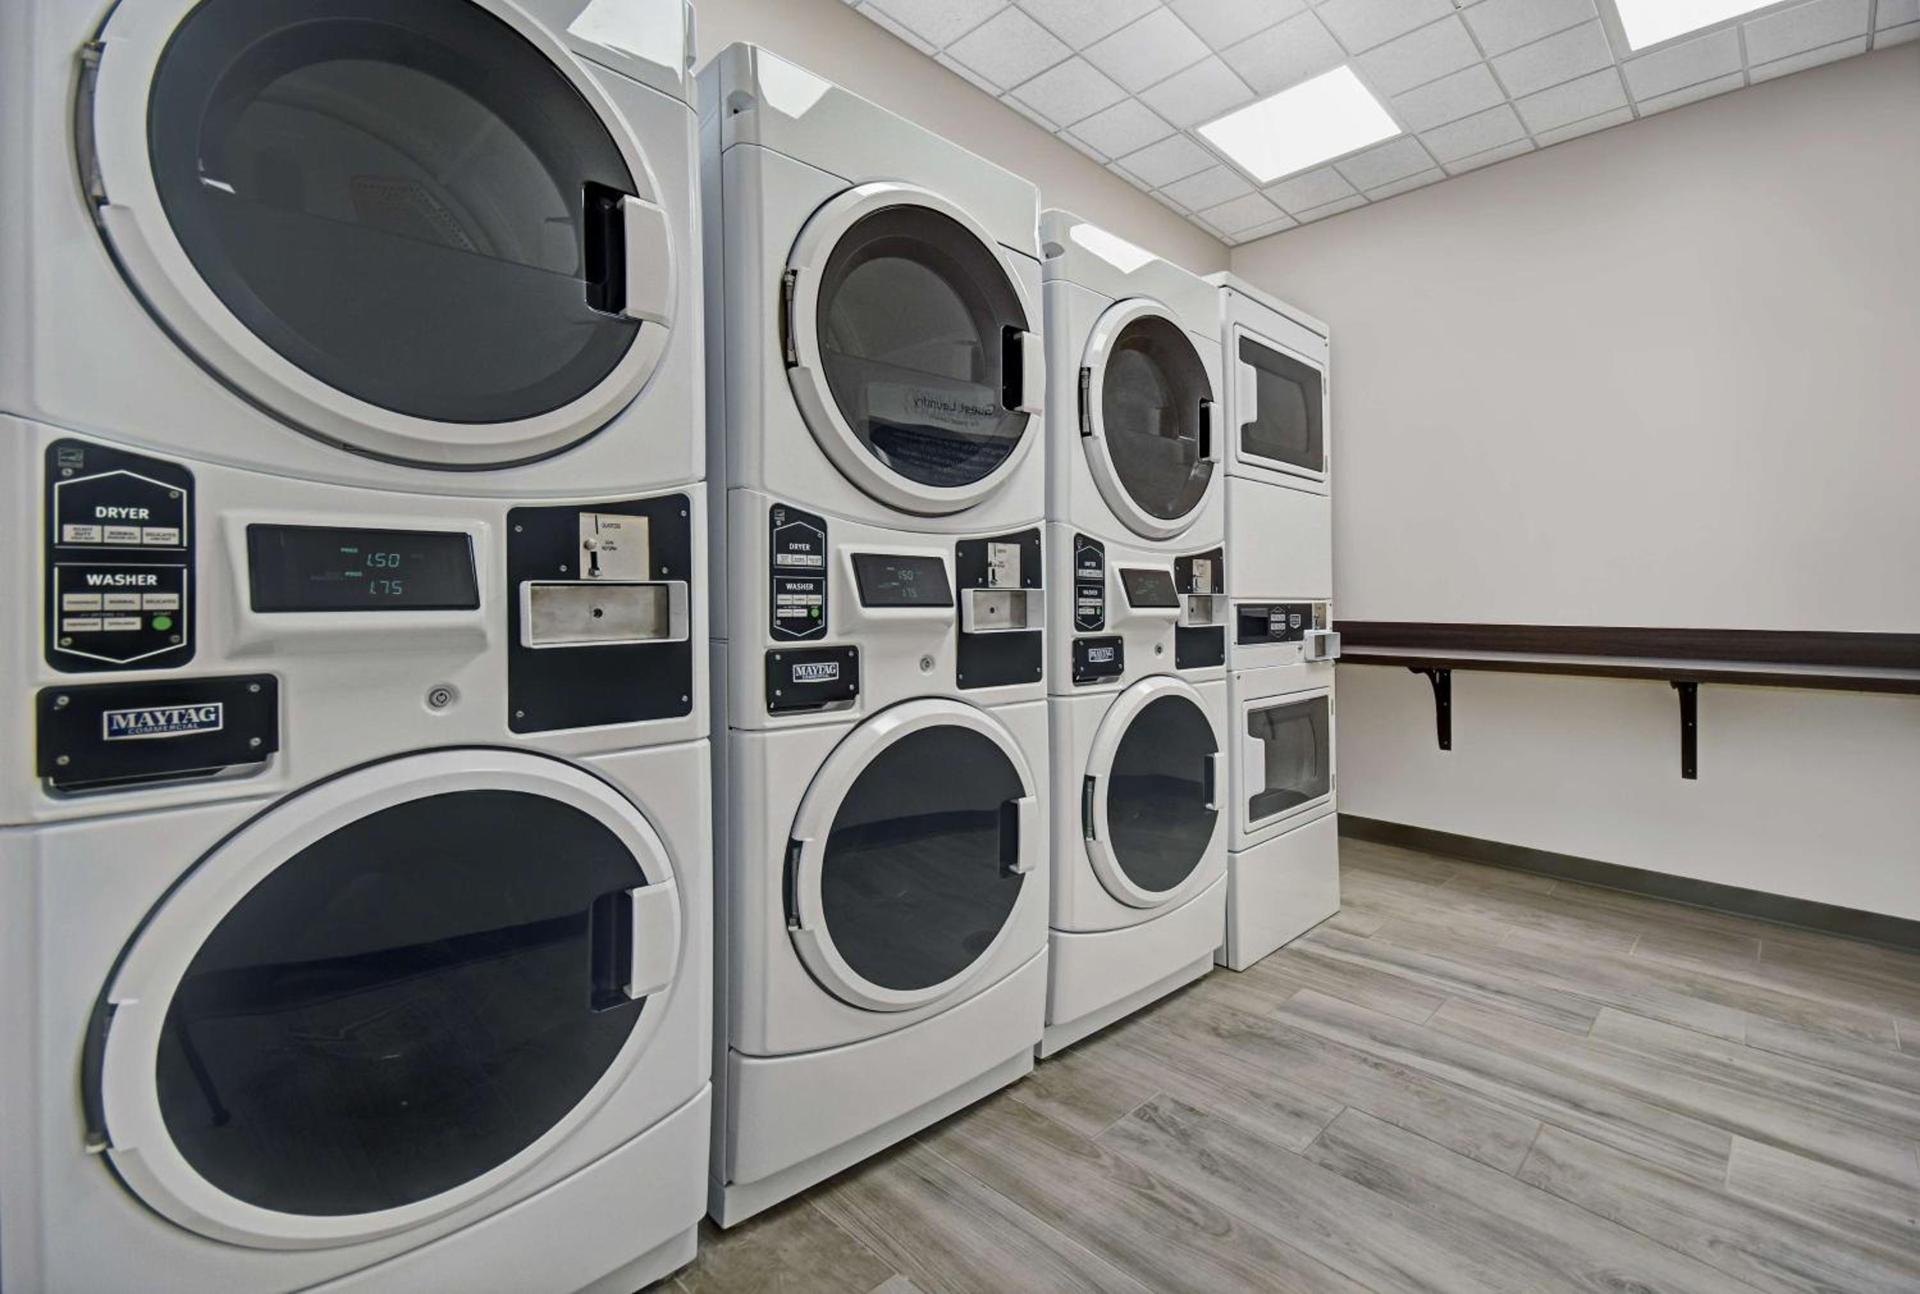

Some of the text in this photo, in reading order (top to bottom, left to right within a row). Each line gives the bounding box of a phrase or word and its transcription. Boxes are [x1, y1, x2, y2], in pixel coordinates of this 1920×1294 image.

[95, 506, 150, 520] DRYER
[789, 542, 811, 552] DRYER
[86, 574, 158, 587] WASHER
[786, 583, 814, 591] WASHER
[795, 664, 838, 677] MAYTAG
[111, 707, 217, 730] MAYTAG
[128, 722, 200, 735] COMMERCIAL
